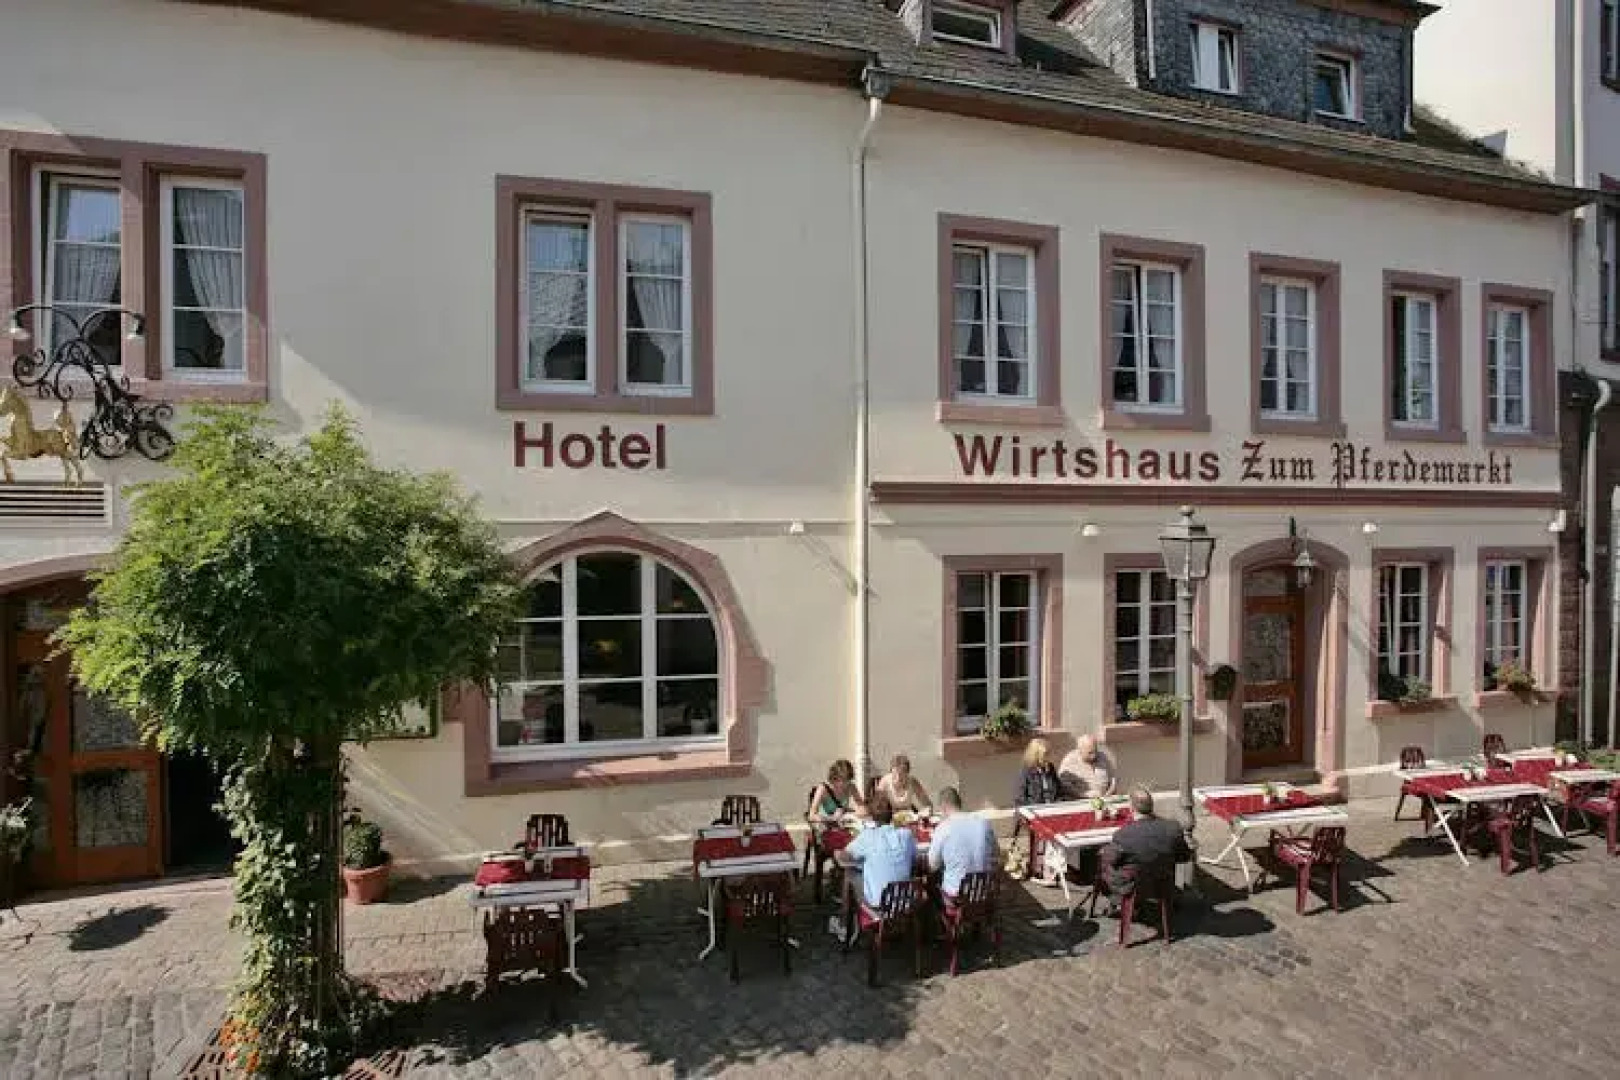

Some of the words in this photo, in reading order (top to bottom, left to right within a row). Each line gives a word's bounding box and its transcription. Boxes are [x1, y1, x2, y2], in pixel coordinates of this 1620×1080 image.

[514, 421, 666, 470] Hotel
[954, 434, 1221, 480] Wirtshaus
[1241, 440, 1316, 481] Zum
[1331, 442, 1513, 488] Pferdemarkt
